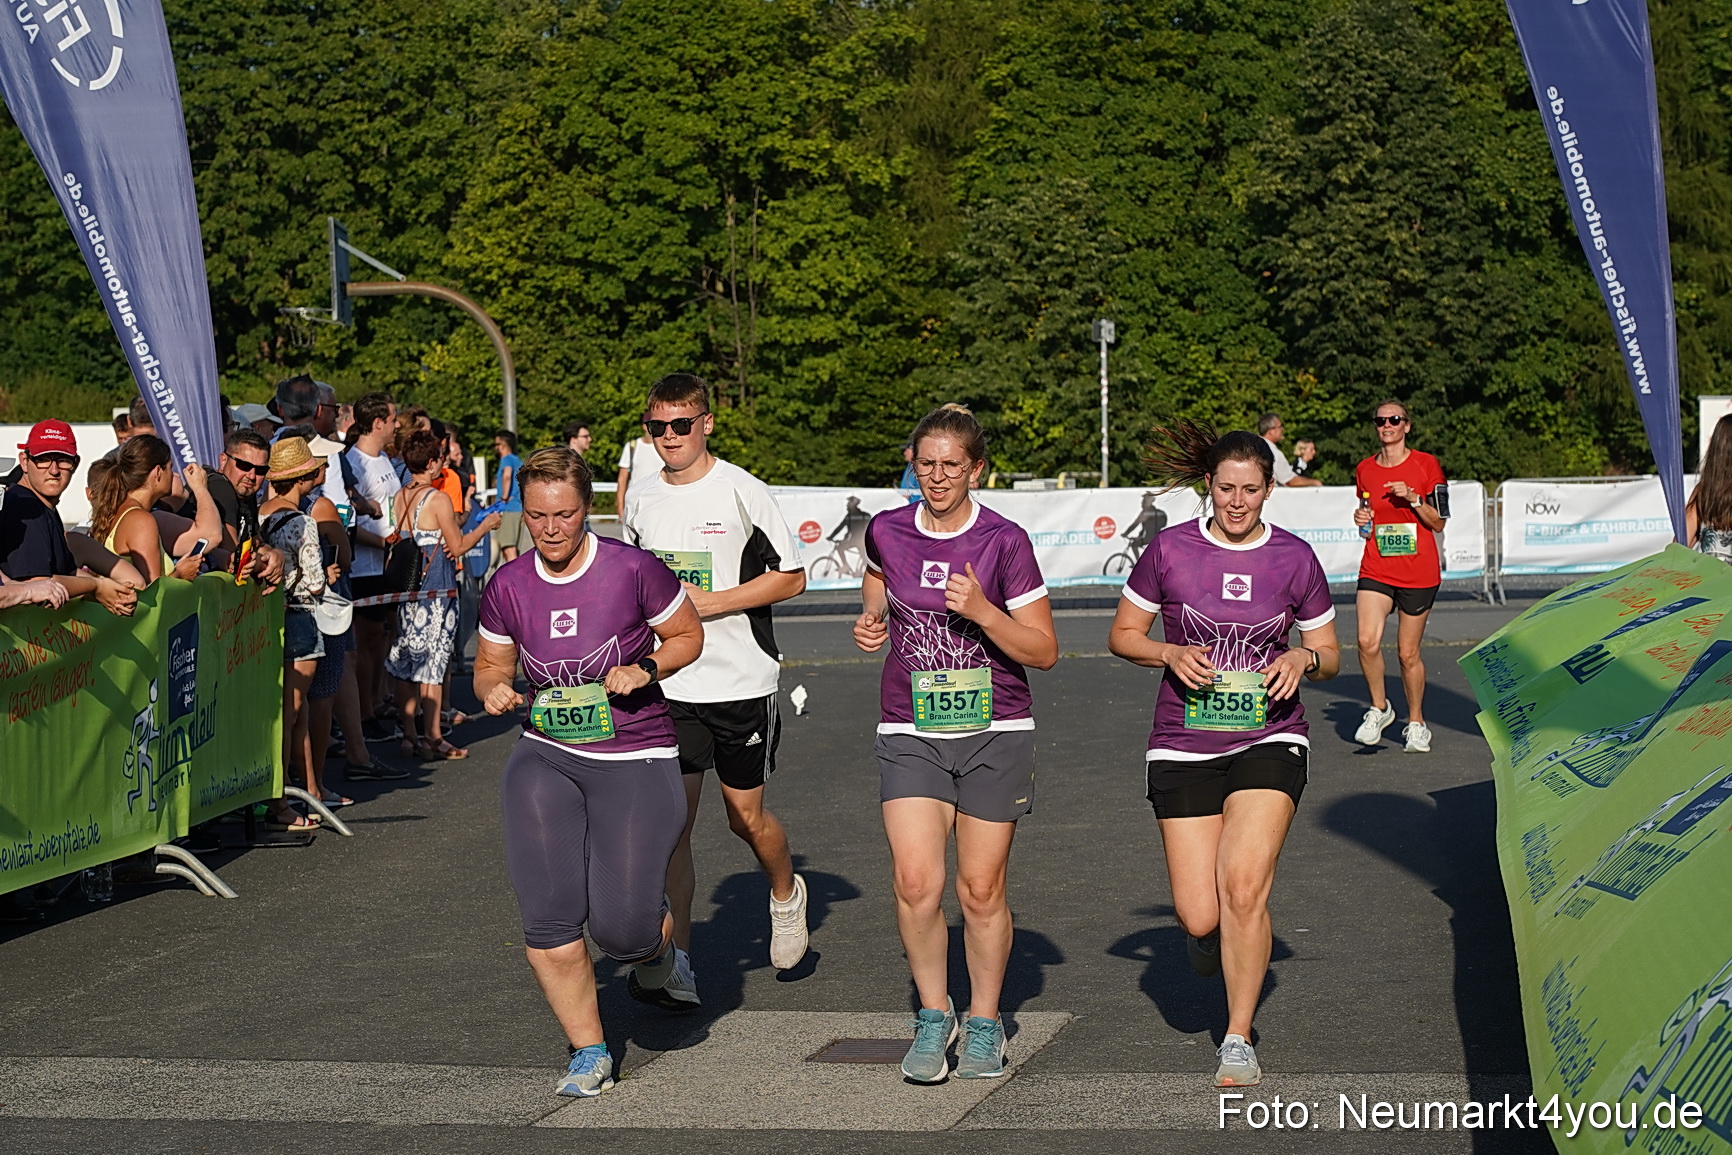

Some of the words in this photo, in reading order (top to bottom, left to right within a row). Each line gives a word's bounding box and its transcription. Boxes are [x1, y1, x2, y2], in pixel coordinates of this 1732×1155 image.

[1525, 502, 1561, 515] NOW
[1299, 527, 1361, 543] FAHRRÄD
[1381, 534, 1410, 546] 1685
[1527, 524, 1577, 537] E-BIKES
[1579, 523, 1590, 534] &
[0, 626, 48, 679] esunde
[917, 698, 925, 719] RUN
[926, 690, 979, 711] 1557
[981, 692, 989, 719] 2022
[1201, 691, 1254, 712] 1558
[1255, 696, 1264, 723] 2022
[543, 705, 596, 726] 1567
[598, 705, 610, 732] 2022
[1219, 713, 1250, 721] Stefanie
